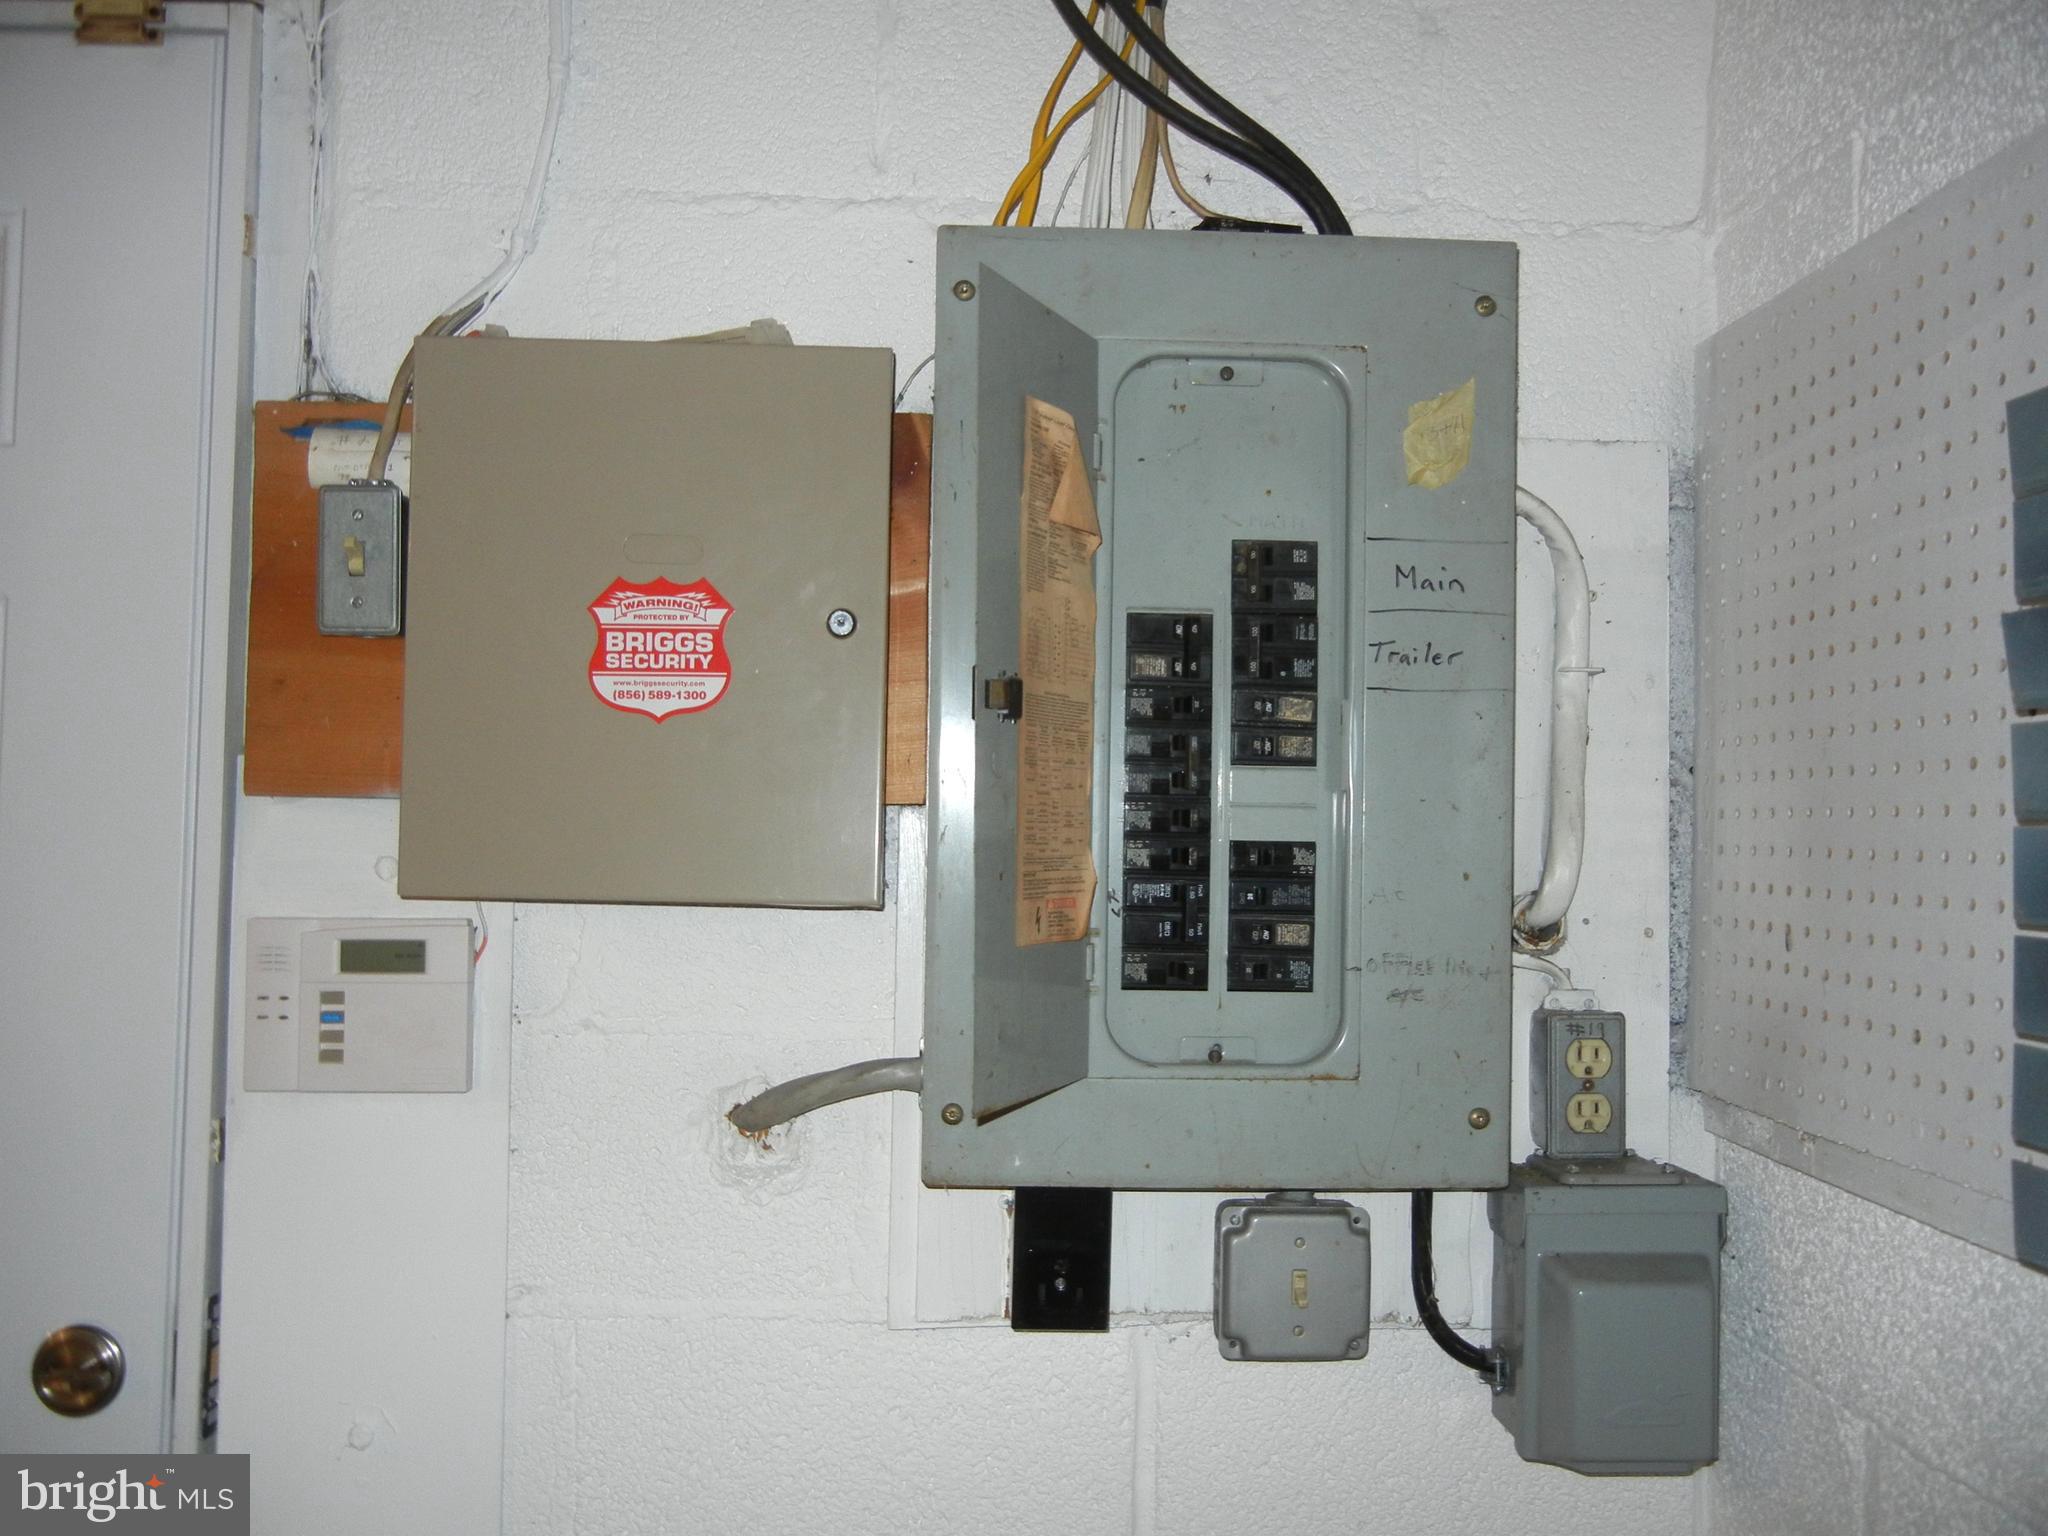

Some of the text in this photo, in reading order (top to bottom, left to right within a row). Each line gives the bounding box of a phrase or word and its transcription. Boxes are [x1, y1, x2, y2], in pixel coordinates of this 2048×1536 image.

[1395, 564, 1465, 593] Main
[623, 598, 699, 612] WARNING!
[605, 631, 714, 653] BRIGGS
[605, 653, 713, 669] SECURITY
[1368, 640, 1464, 666] Trailer
[613, 680, 706, 688] www.briggssecurity.com
[613, 690, 707, 701] (856) 589-1300
